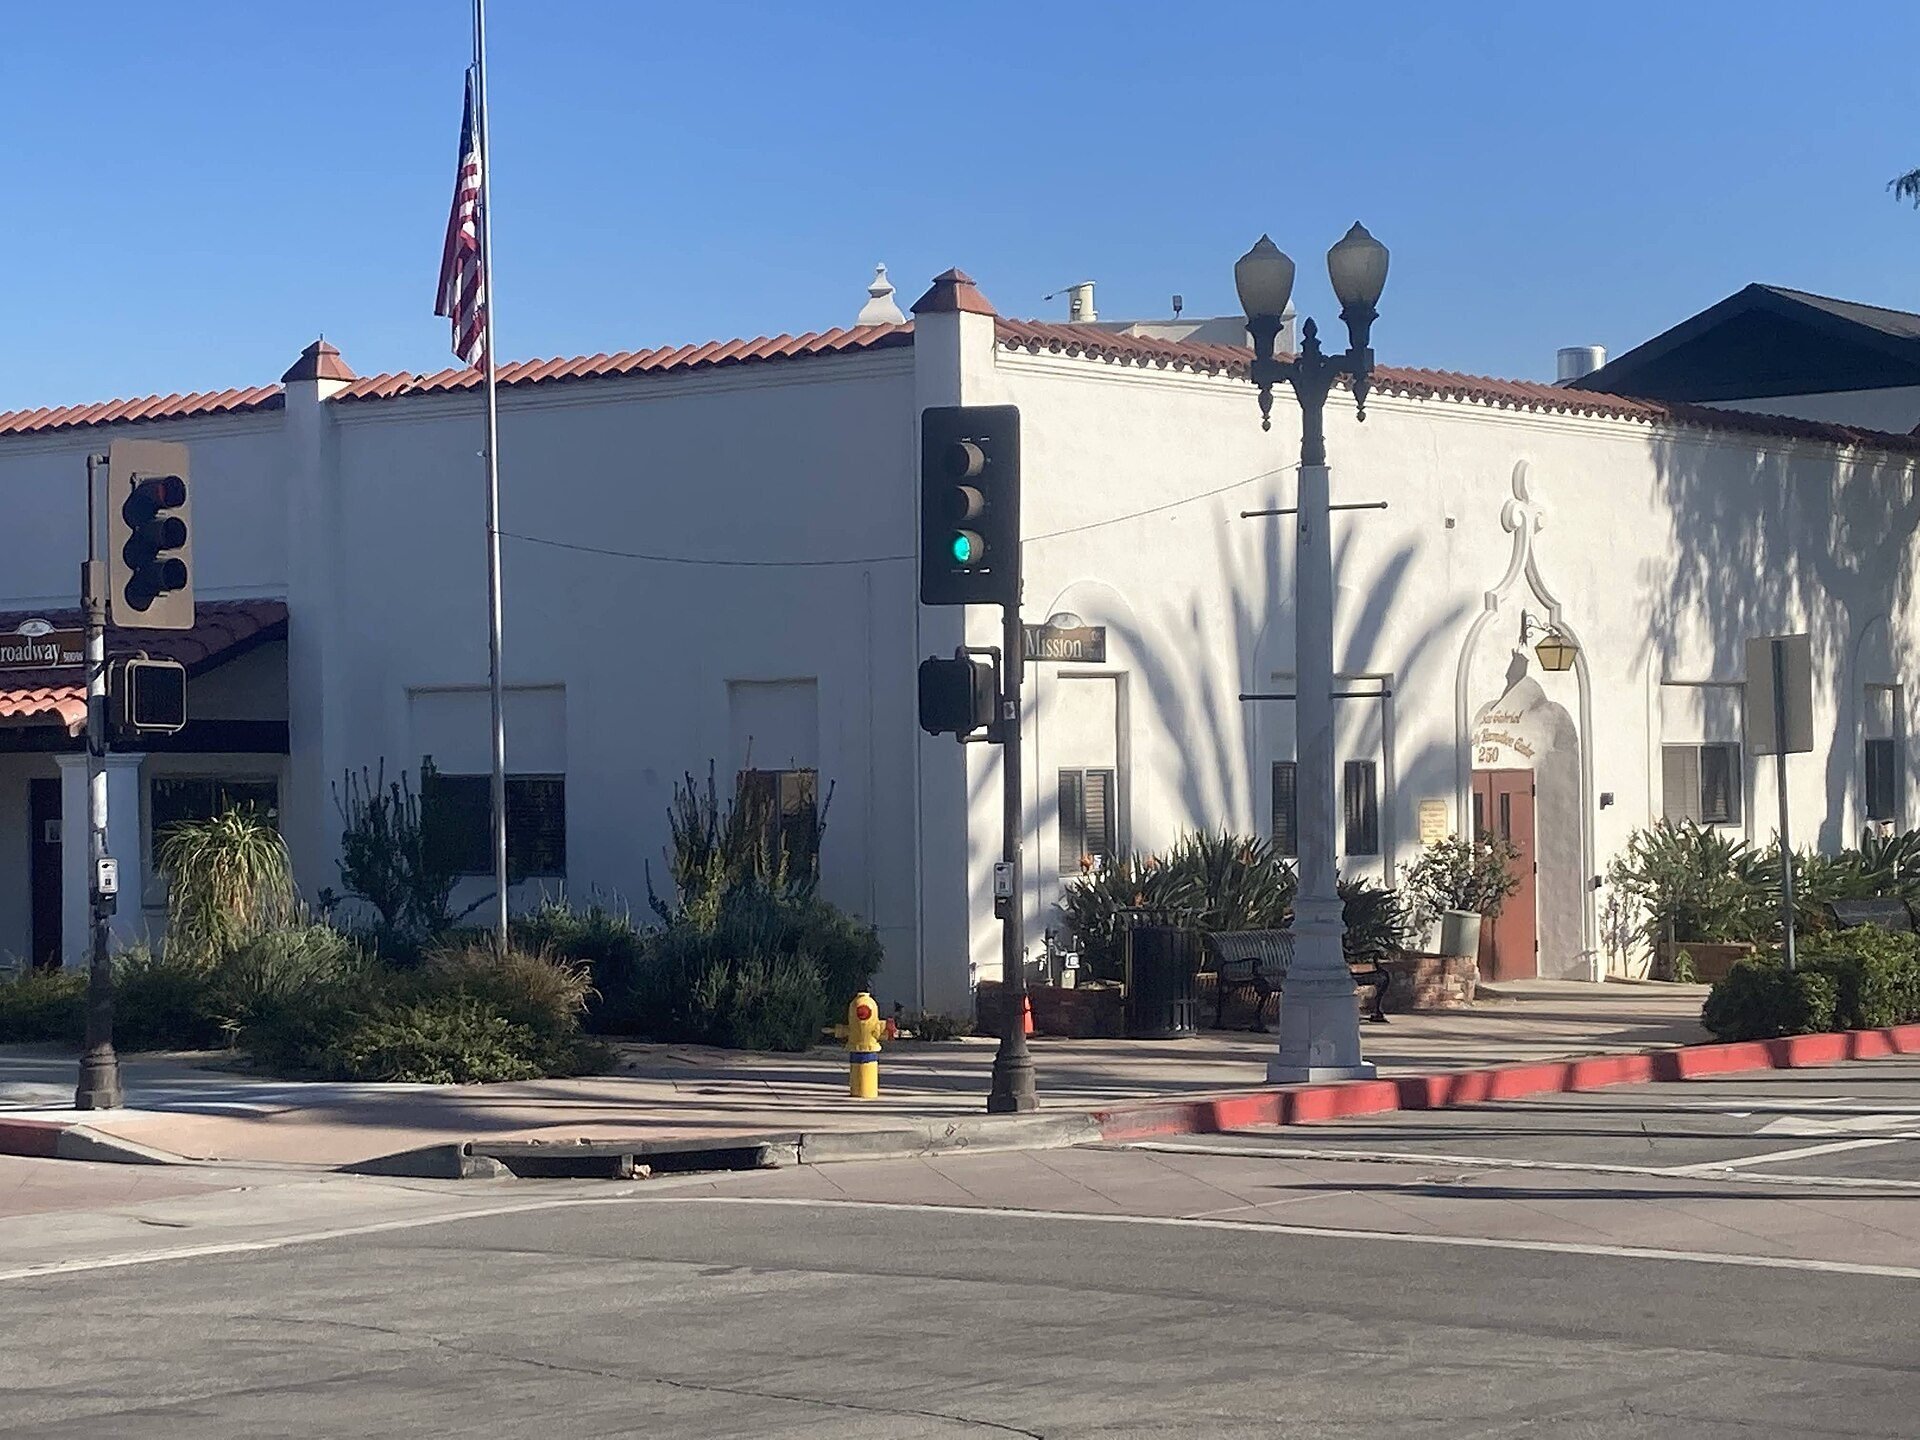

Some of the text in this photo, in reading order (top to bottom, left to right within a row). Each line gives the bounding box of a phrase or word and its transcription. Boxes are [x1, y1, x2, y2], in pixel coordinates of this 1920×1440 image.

[0, 637, 60, 667] roadway
[1024, 627, 1083, 658] Mission
[1493, 709, 1524, 724] Gabriel
[1478, 746, 1499, 763] 250
